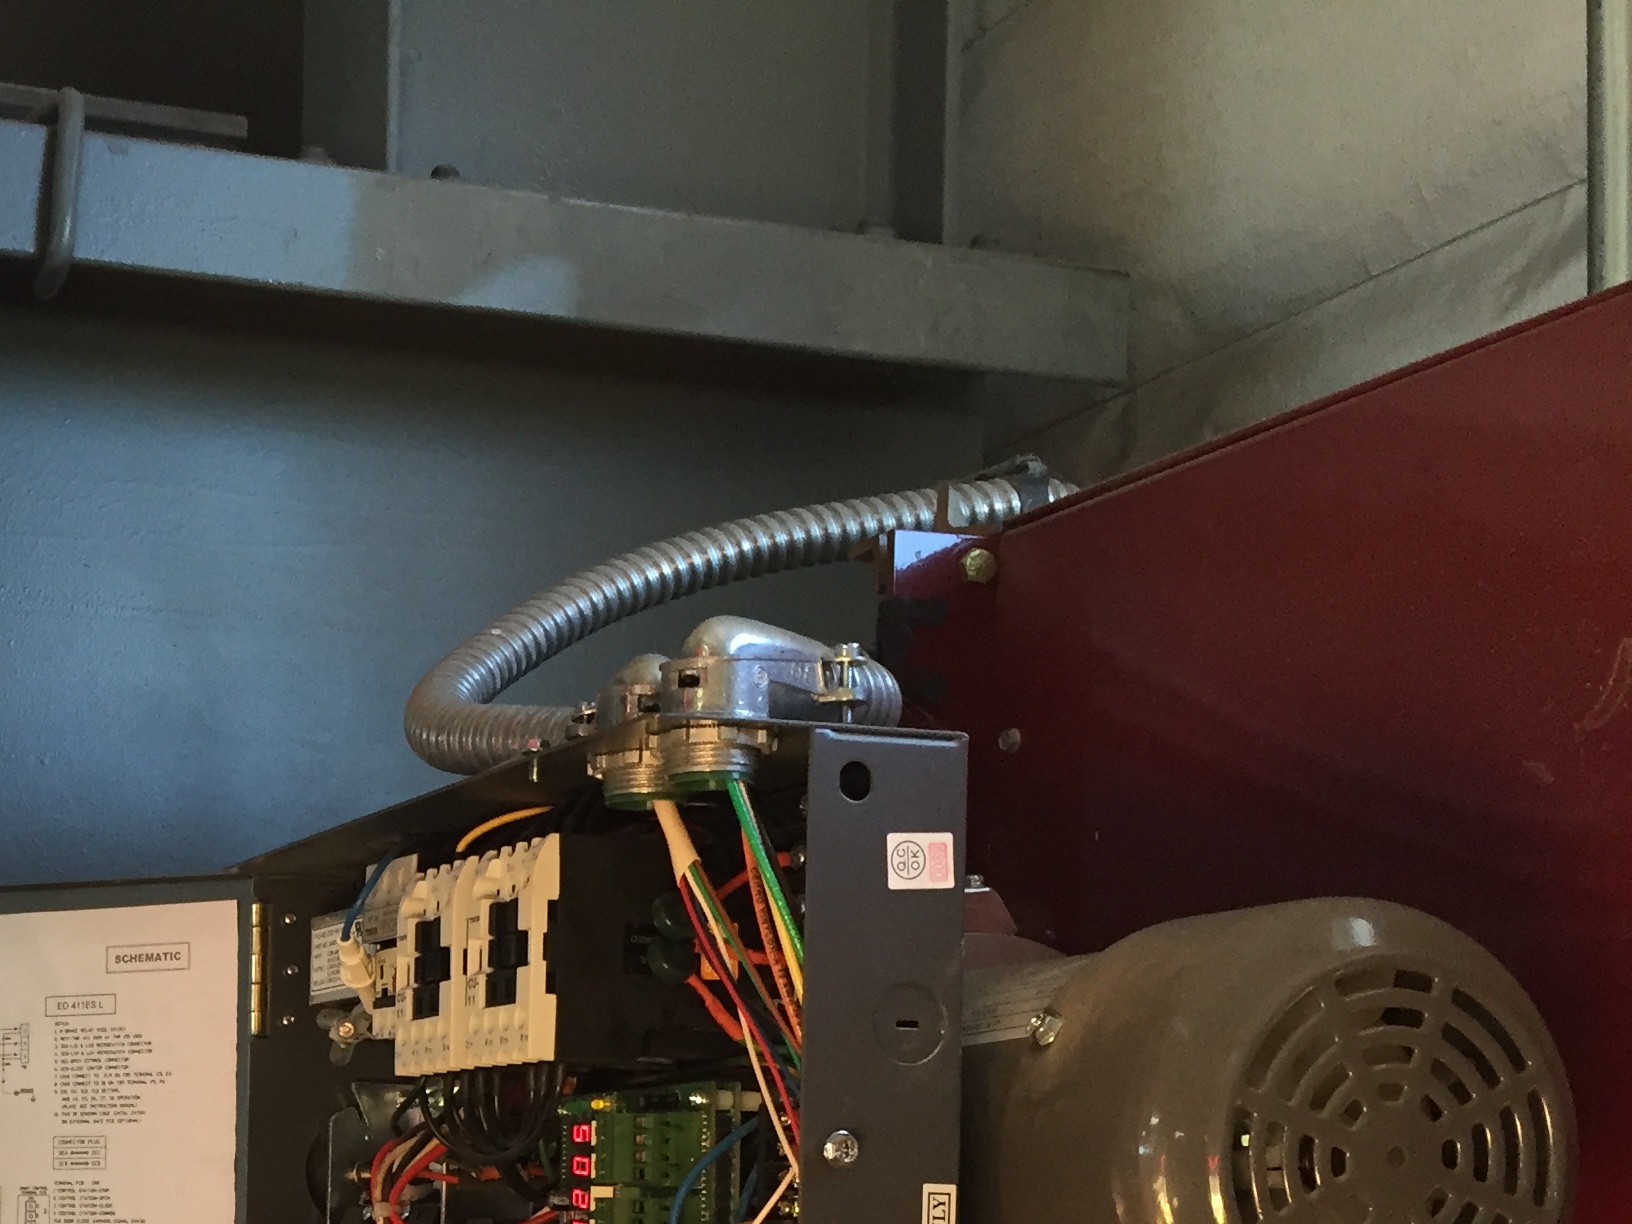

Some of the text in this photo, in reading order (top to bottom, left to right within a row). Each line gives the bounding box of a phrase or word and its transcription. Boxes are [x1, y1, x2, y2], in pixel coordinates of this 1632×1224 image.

[910, 849, 920, 871] OK
[114, 951, 182, 964] SCHEMATIC
[57, 1002, 68, 1010] ED
